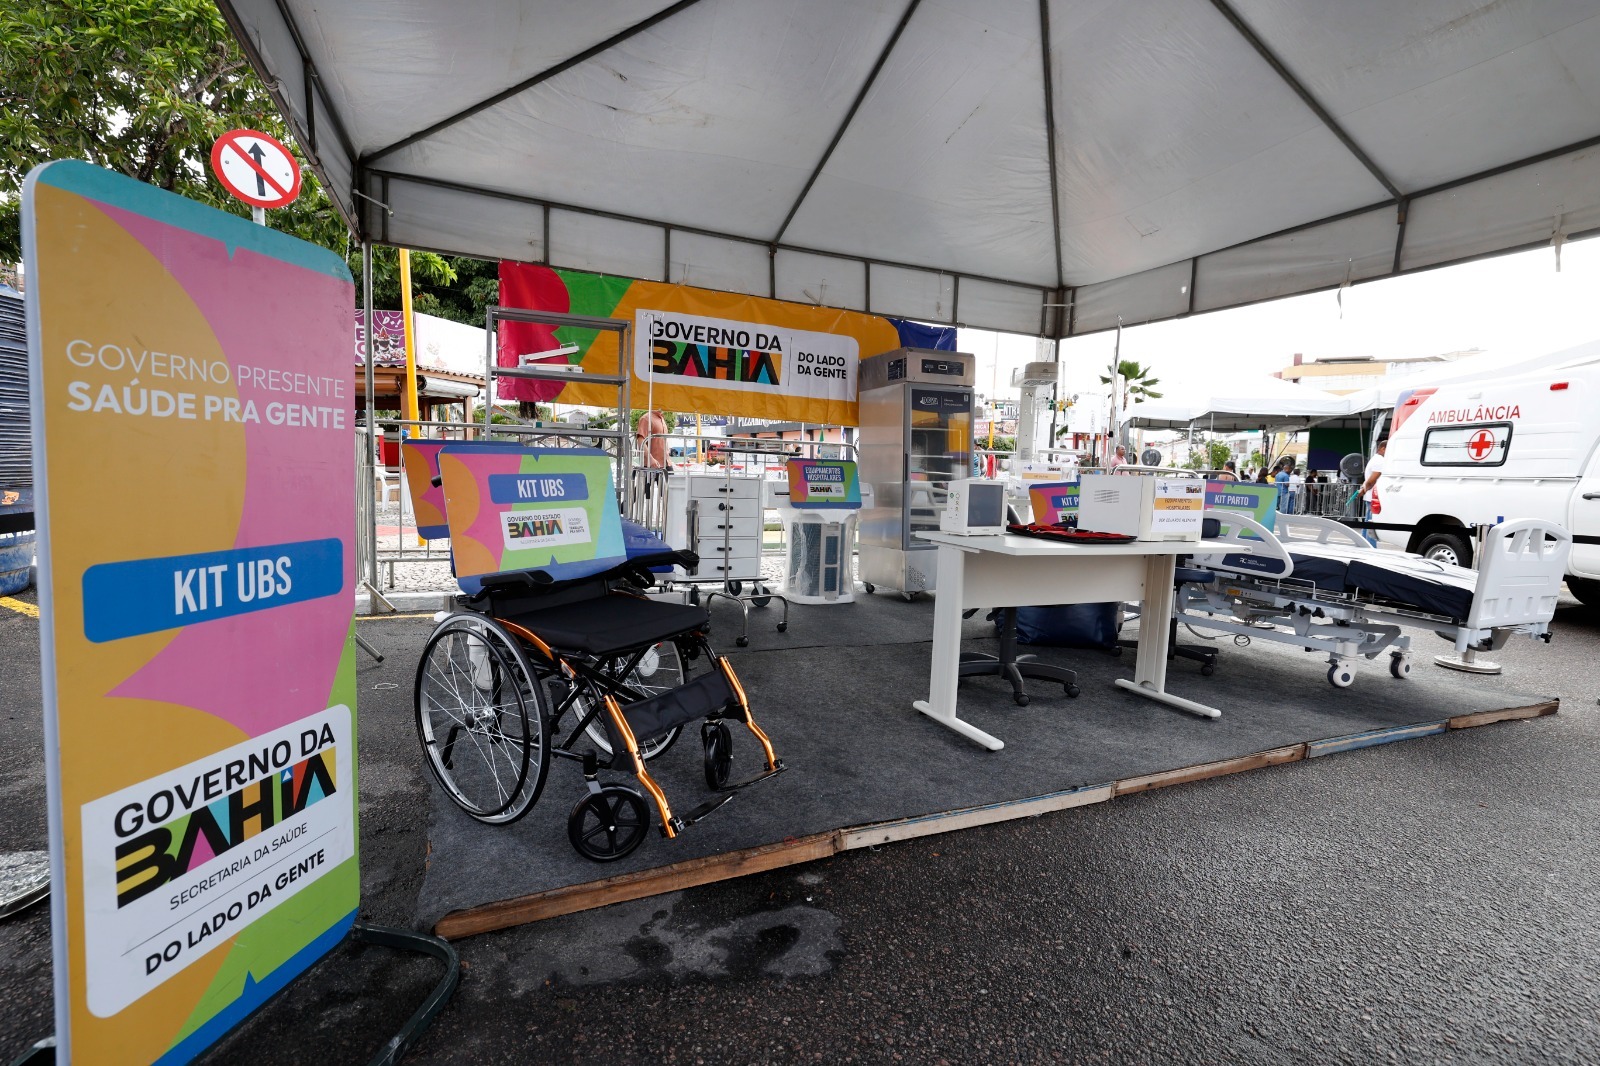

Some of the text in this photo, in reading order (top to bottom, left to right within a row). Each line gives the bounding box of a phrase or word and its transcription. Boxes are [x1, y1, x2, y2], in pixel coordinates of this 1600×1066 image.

[648, 320, 782, 351] GOVERNO DA
[66, 340, 345, 399] GOVERNO PRESENTE
[648, 339, 781, 385] BAHIA
[798, 352, 845, 366] DO LADO
[798, 364, 846, 380] DA GENTE
[67, 378, 345, 430] SAÚDE PRA GENTE
[1428, 404, 1520, 423] AMBULÂNCIA
[517, 478, 565, 498] KIT UBS
[1061, 497, 1073, 506] KIT
[1215, 495, 1249, 506] KIT PARTO
[508, 520, 563, 538] BAHIA
[173, 555, 293, 615] KIT UBS
[114, 722, 336, 838] GOVERNO DA
[114, 750, 337, 909] BAHIA
[170, 821, 307, 910] SECRETARIA DA SAÚDE
[146, 848, 325, 976] DO LADO DA GENTE
